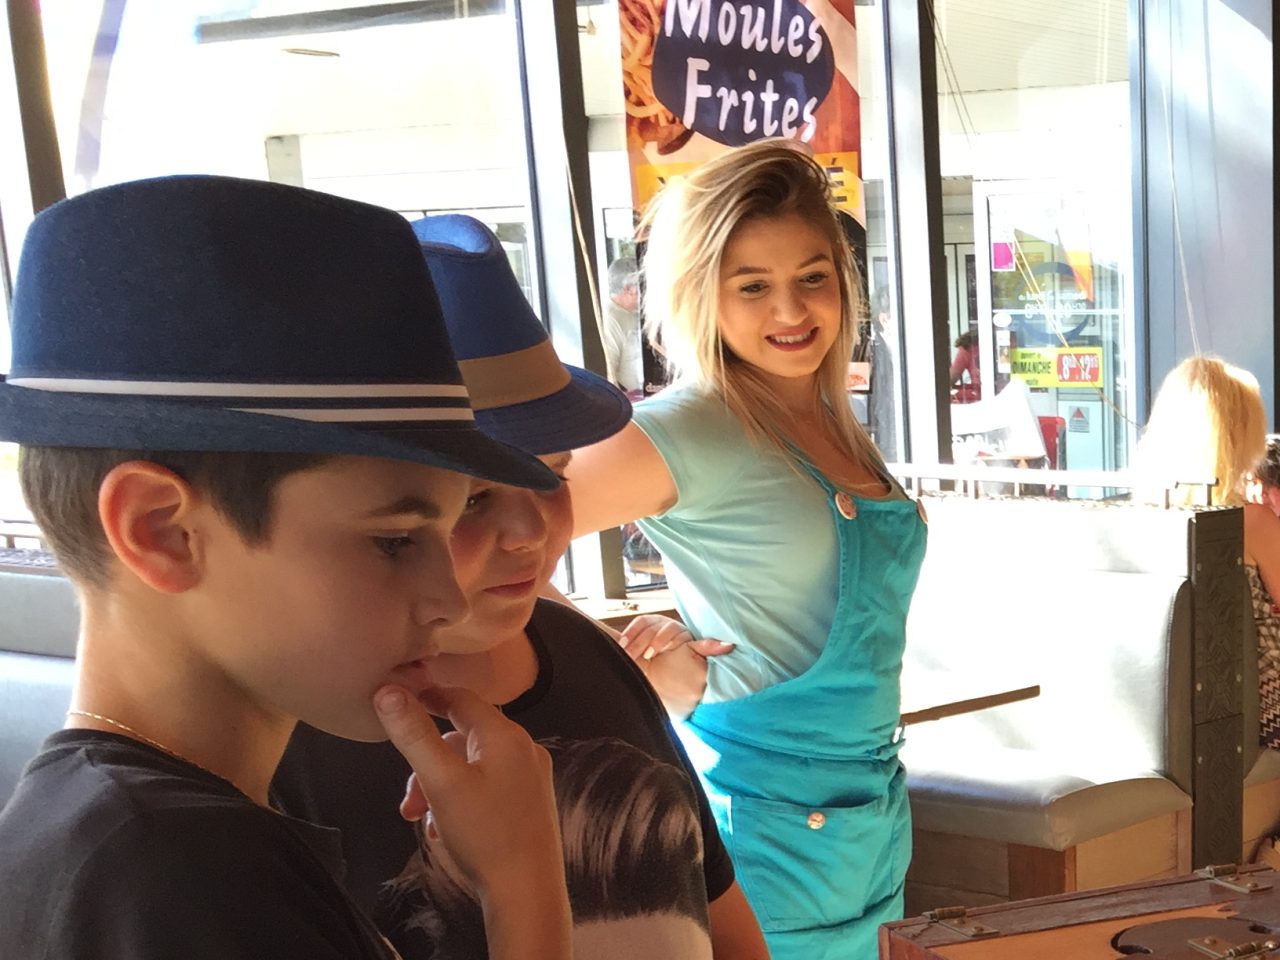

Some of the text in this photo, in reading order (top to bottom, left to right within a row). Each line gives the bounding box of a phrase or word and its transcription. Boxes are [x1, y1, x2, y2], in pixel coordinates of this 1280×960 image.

[664, 0, 823, 64] Moules
[683, 57, 818, 143] Frites
[1012, 362, 1051, 374] DIMANCHE
